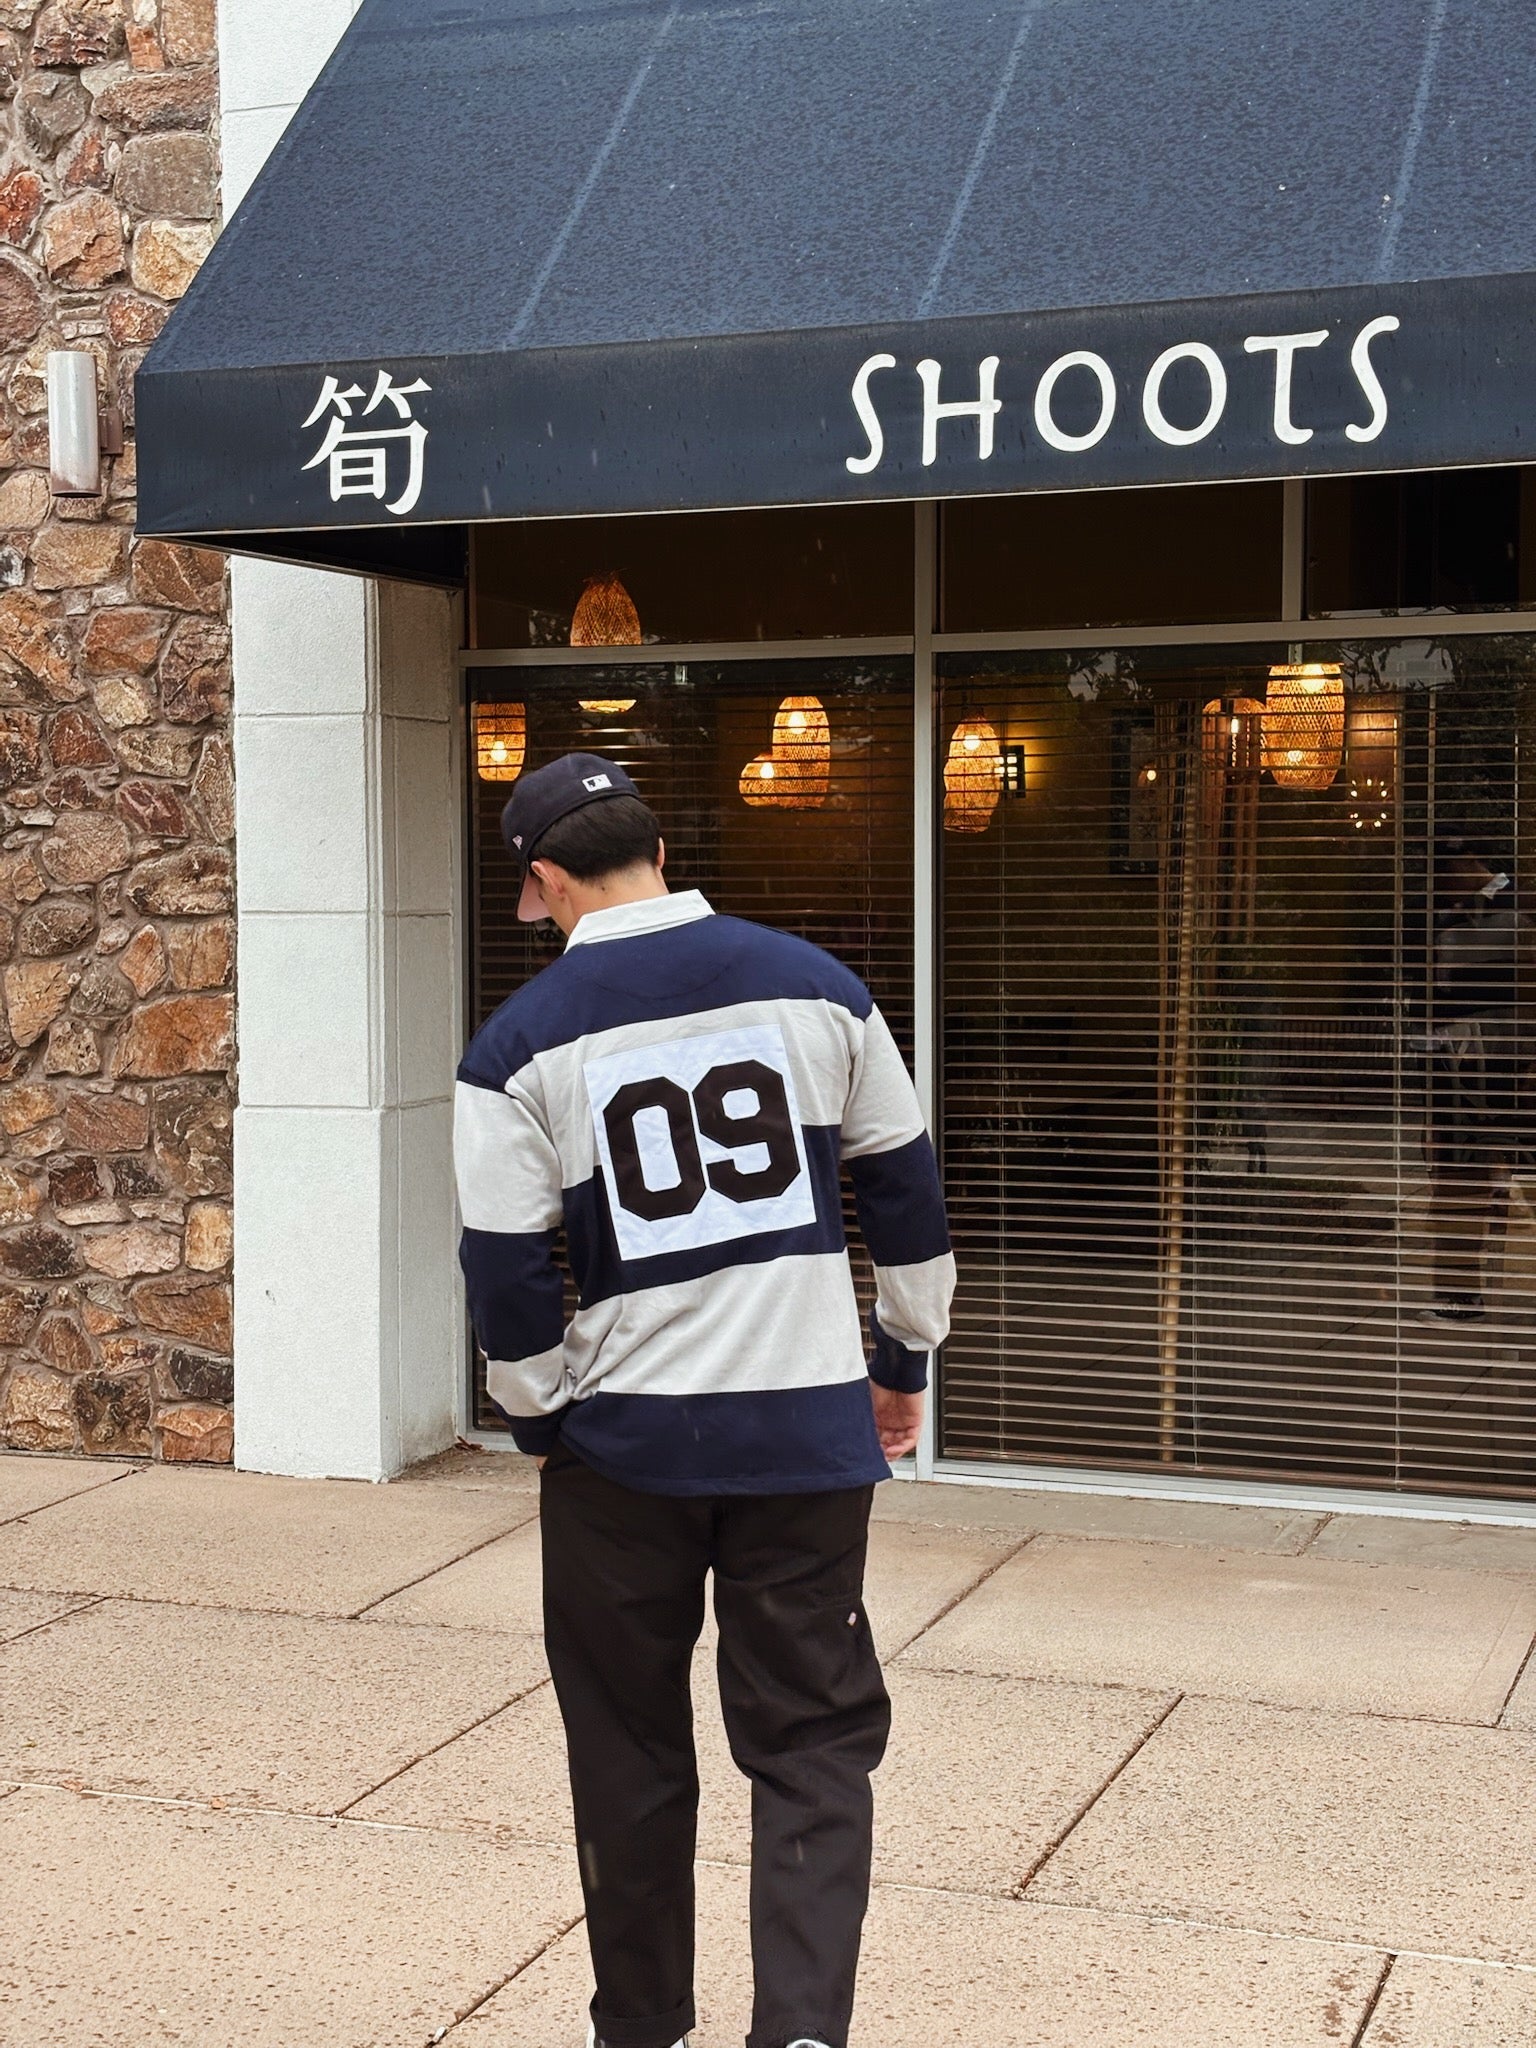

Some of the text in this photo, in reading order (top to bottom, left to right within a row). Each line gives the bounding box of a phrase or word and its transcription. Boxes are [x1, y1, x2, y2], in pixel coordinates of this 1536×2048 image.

[300, 369, 433, 515] 筍
[845, 315, 1400, 475] SHOOTS
[602, 1058, 802, 1223] 09
